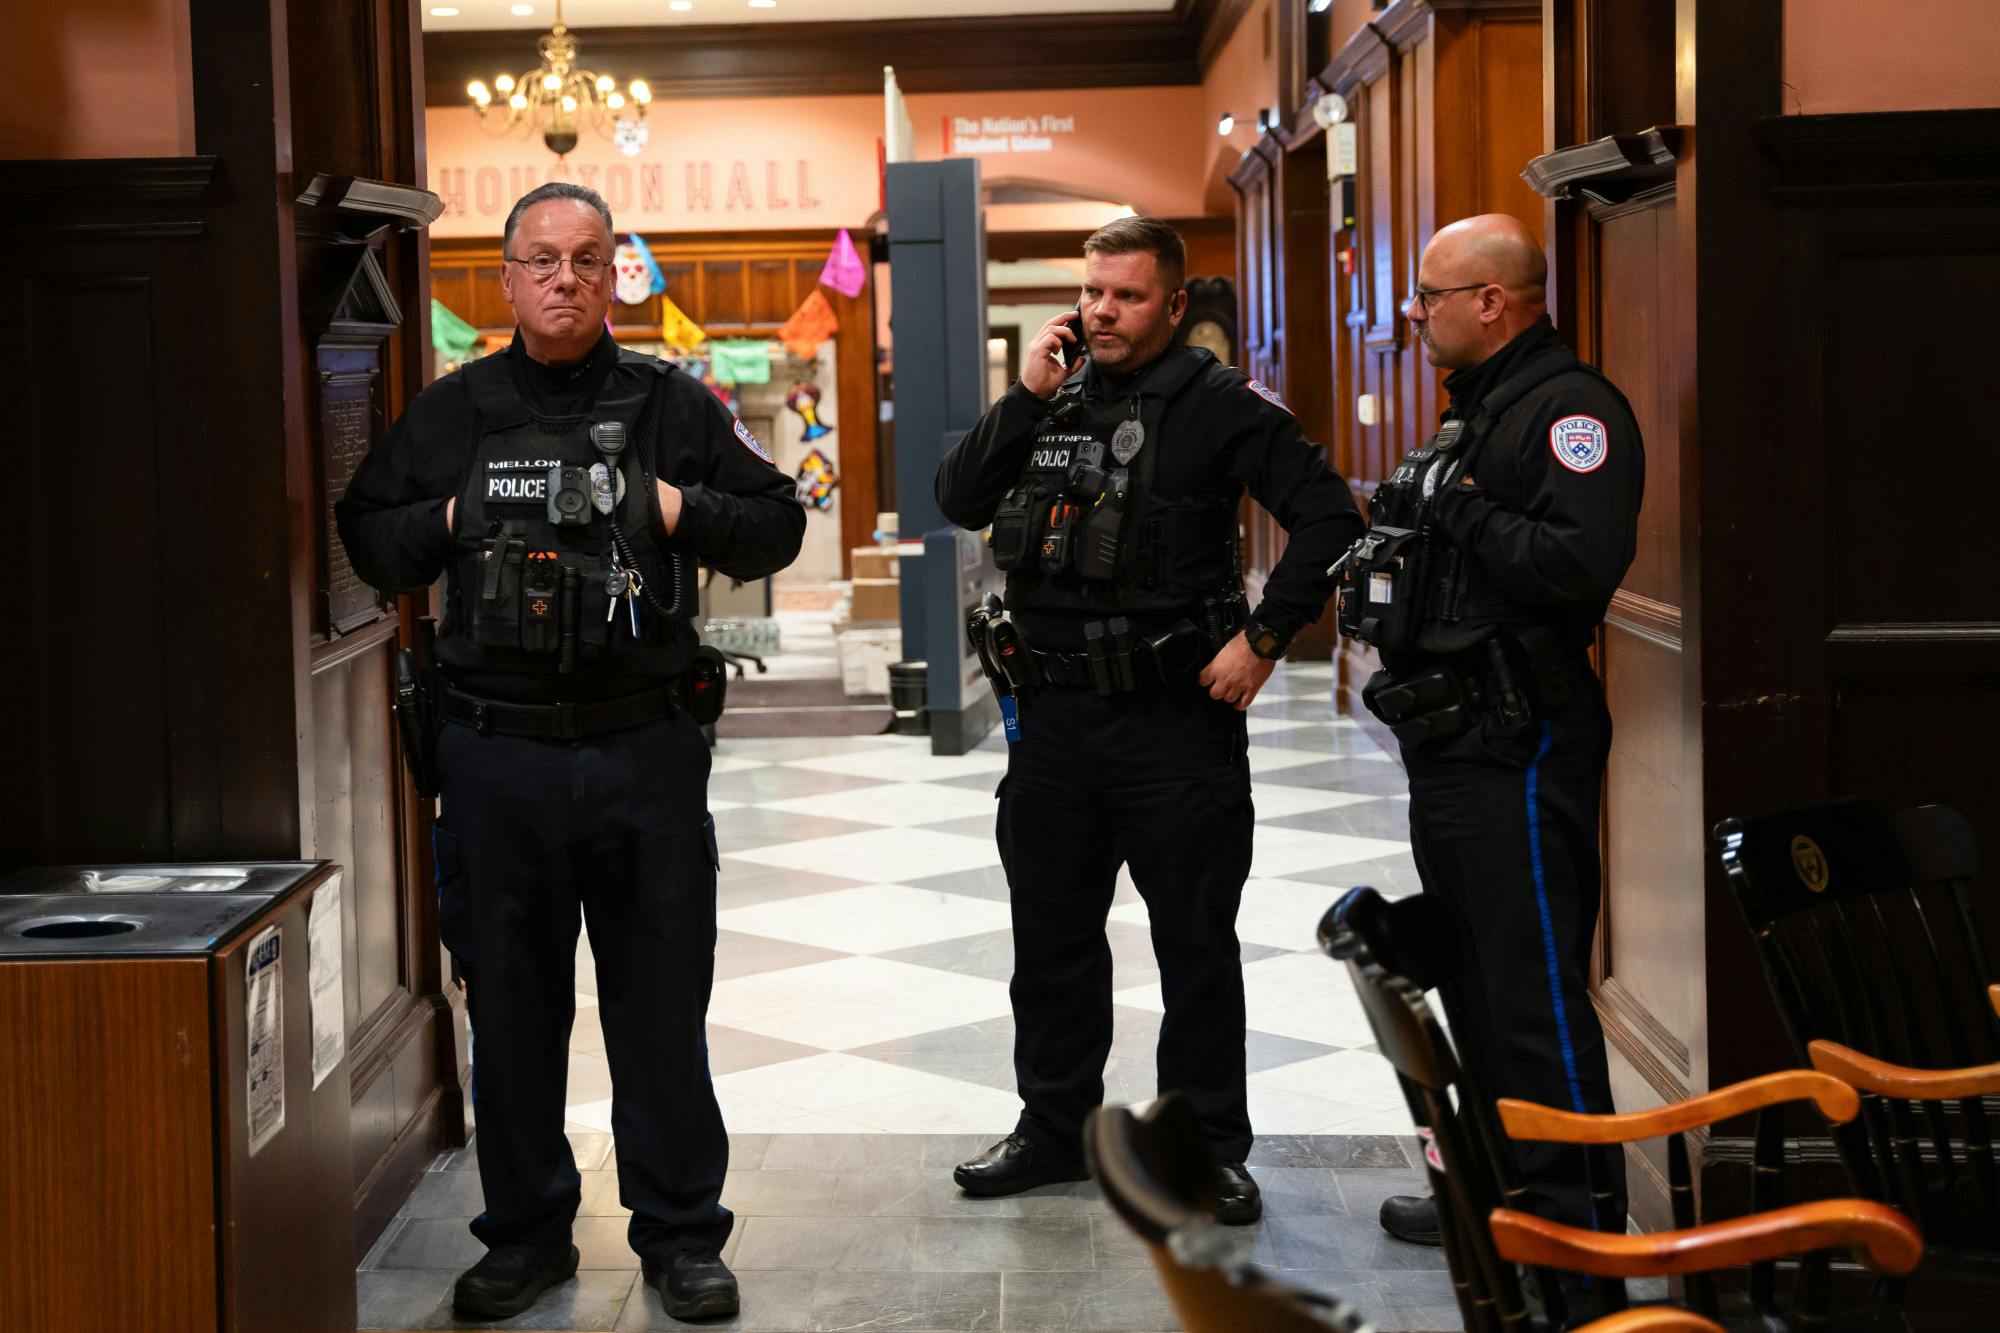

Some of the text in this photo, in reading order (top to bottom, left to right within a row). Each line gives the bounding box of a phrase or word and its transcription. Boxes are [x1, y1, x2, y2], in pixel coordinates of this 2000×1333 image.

[954, 117, 979, 134] The
[1041, 115, 1074, 132] First
[954, 135, 1052, 152] Student Union
[685, 160, 822, 212] HALL
[1559, 421, 1600, 433] POLICE
[488, 459, 561, 469] MELLON
[488, 478, 546, 499] POLICE
[1006, 717, 1016, 729] S1
